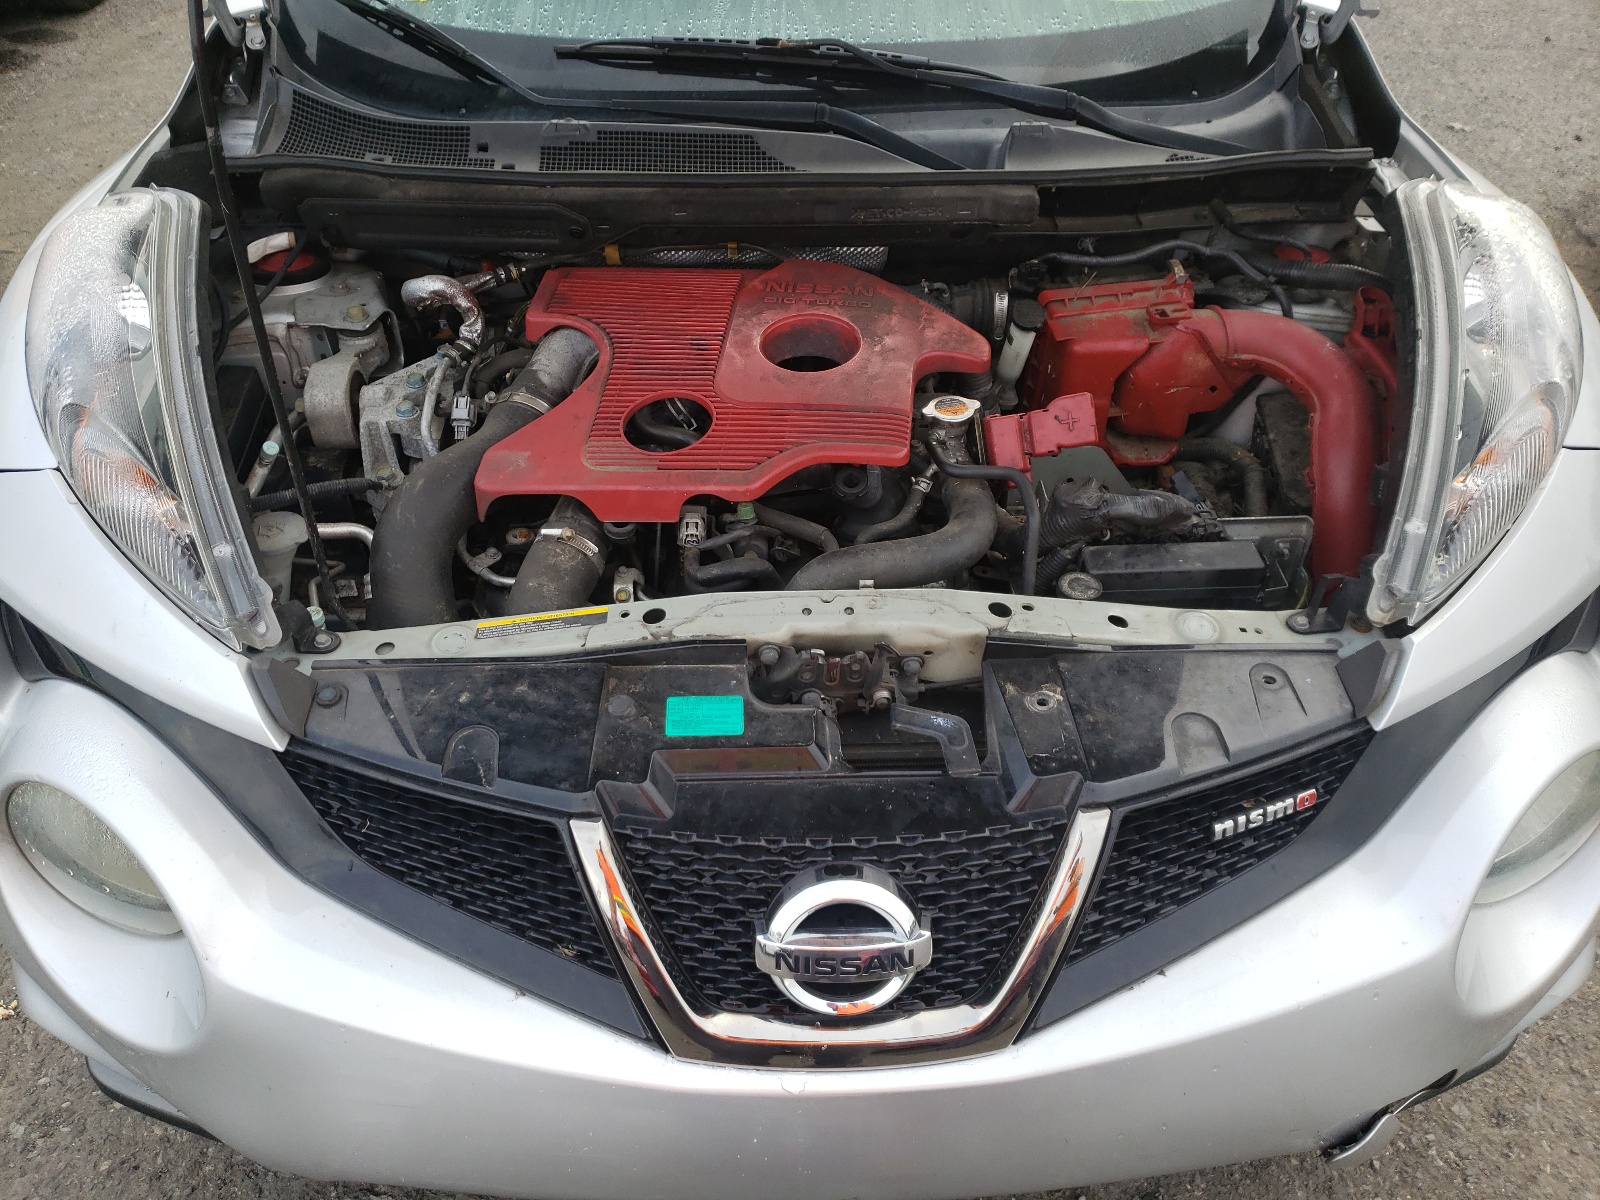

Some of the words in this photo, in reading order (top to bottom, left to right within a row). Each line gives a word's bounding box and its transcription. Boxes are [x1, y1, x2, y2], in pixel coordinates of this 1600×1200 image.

[765, 281, 875, 297] NISSAN
[763, 296, 797, 305] DIG
[801, 298, 872, 308] TURBO
[1213, 788, 1318, 841] nismo
[775, 948, 915, 977] NISSAN
